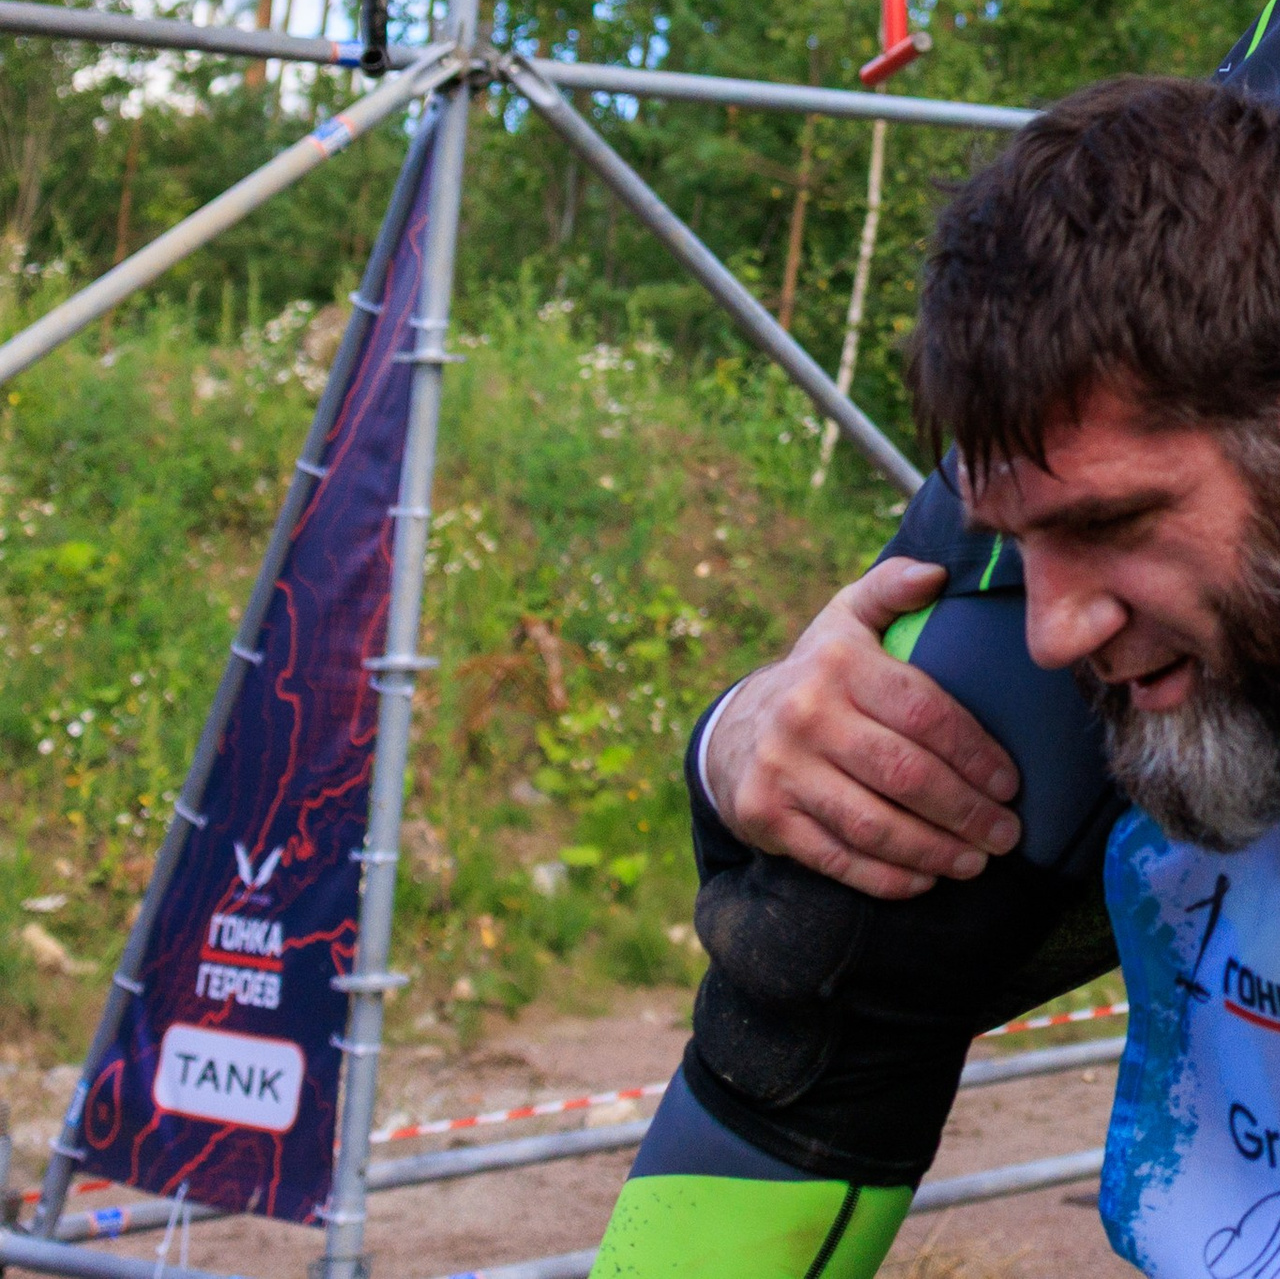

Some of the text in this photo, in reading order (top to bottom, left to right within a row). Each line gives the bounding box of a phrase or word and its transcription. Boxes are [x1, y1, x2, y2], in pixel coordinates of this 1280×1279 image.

[208, 912, 283, 958] ГОНКА
[195, 962, 283, 1010] ГЕРОЕВ
[175, 1053, 286, 1103] TANK
